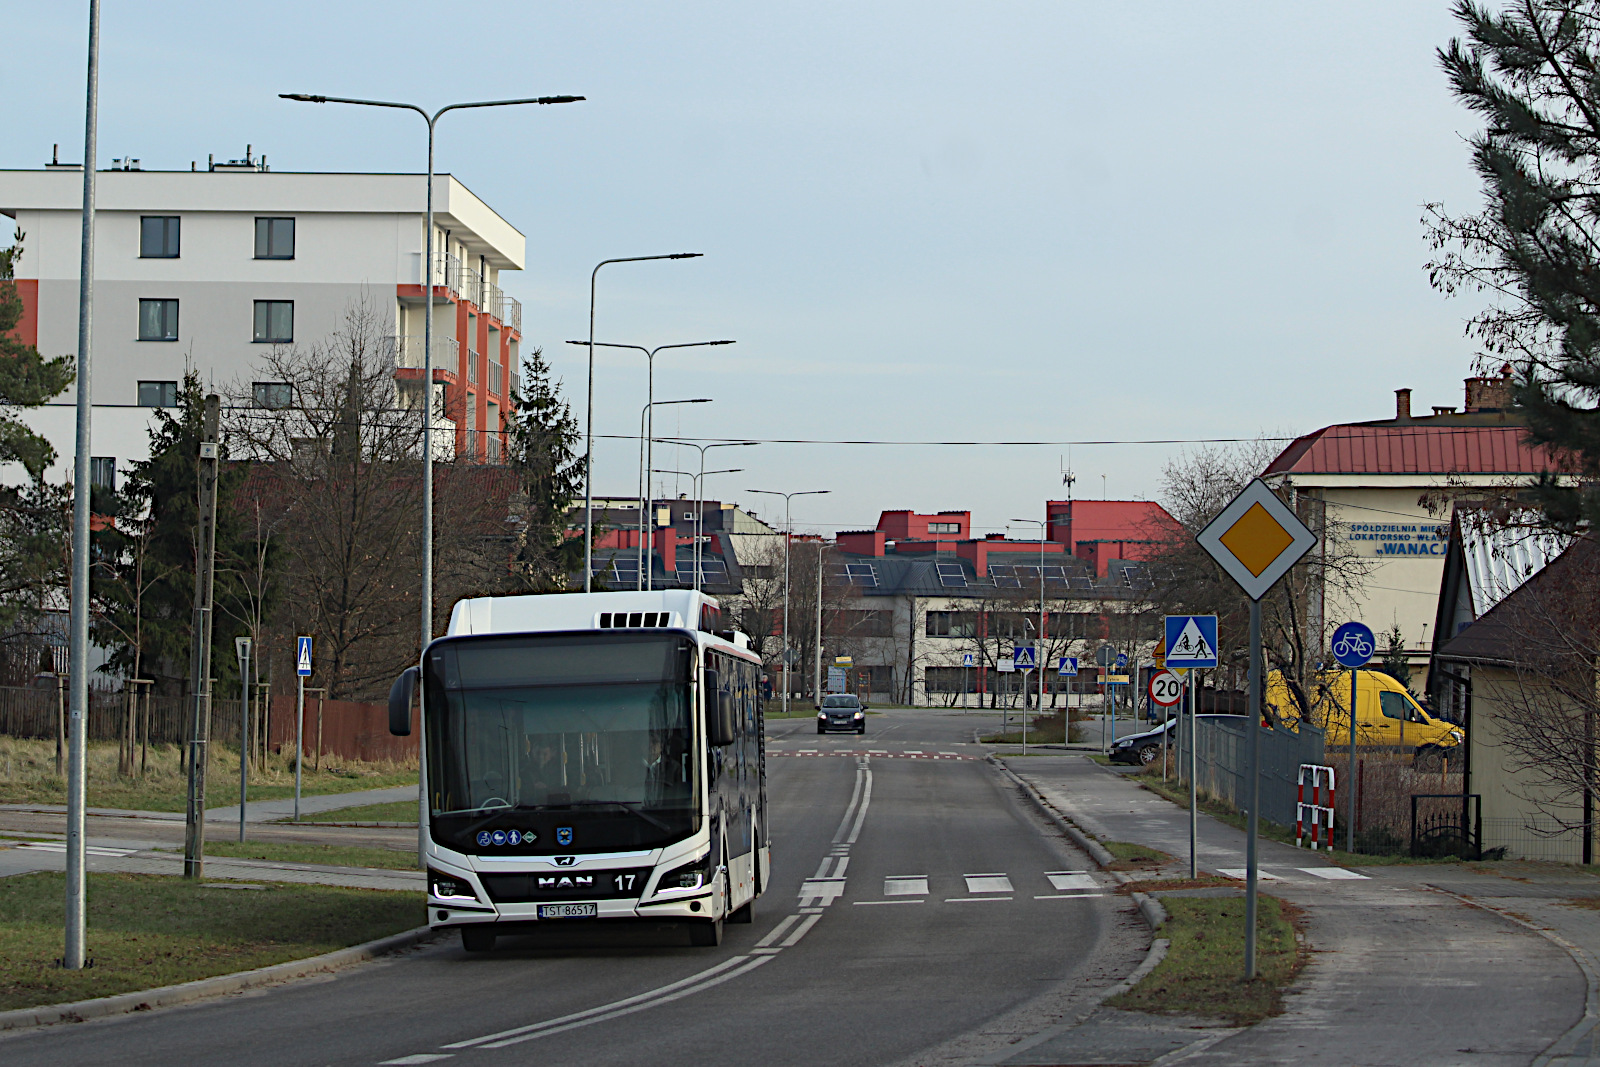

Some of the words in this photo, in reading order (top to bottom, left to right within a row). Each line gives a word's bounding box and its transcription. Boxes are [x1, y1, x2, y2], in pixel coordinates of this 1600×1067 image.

[1351, 524, 1417, 532] SPÓŁDZIELNIA
[1155, 680, 1179, 697] 20
[538, 876, 593, 888] MAN
[615, 874, 636, 890] 17
[543, 906, 562, 916] TST
[565, 904, 595, 916] 86517
